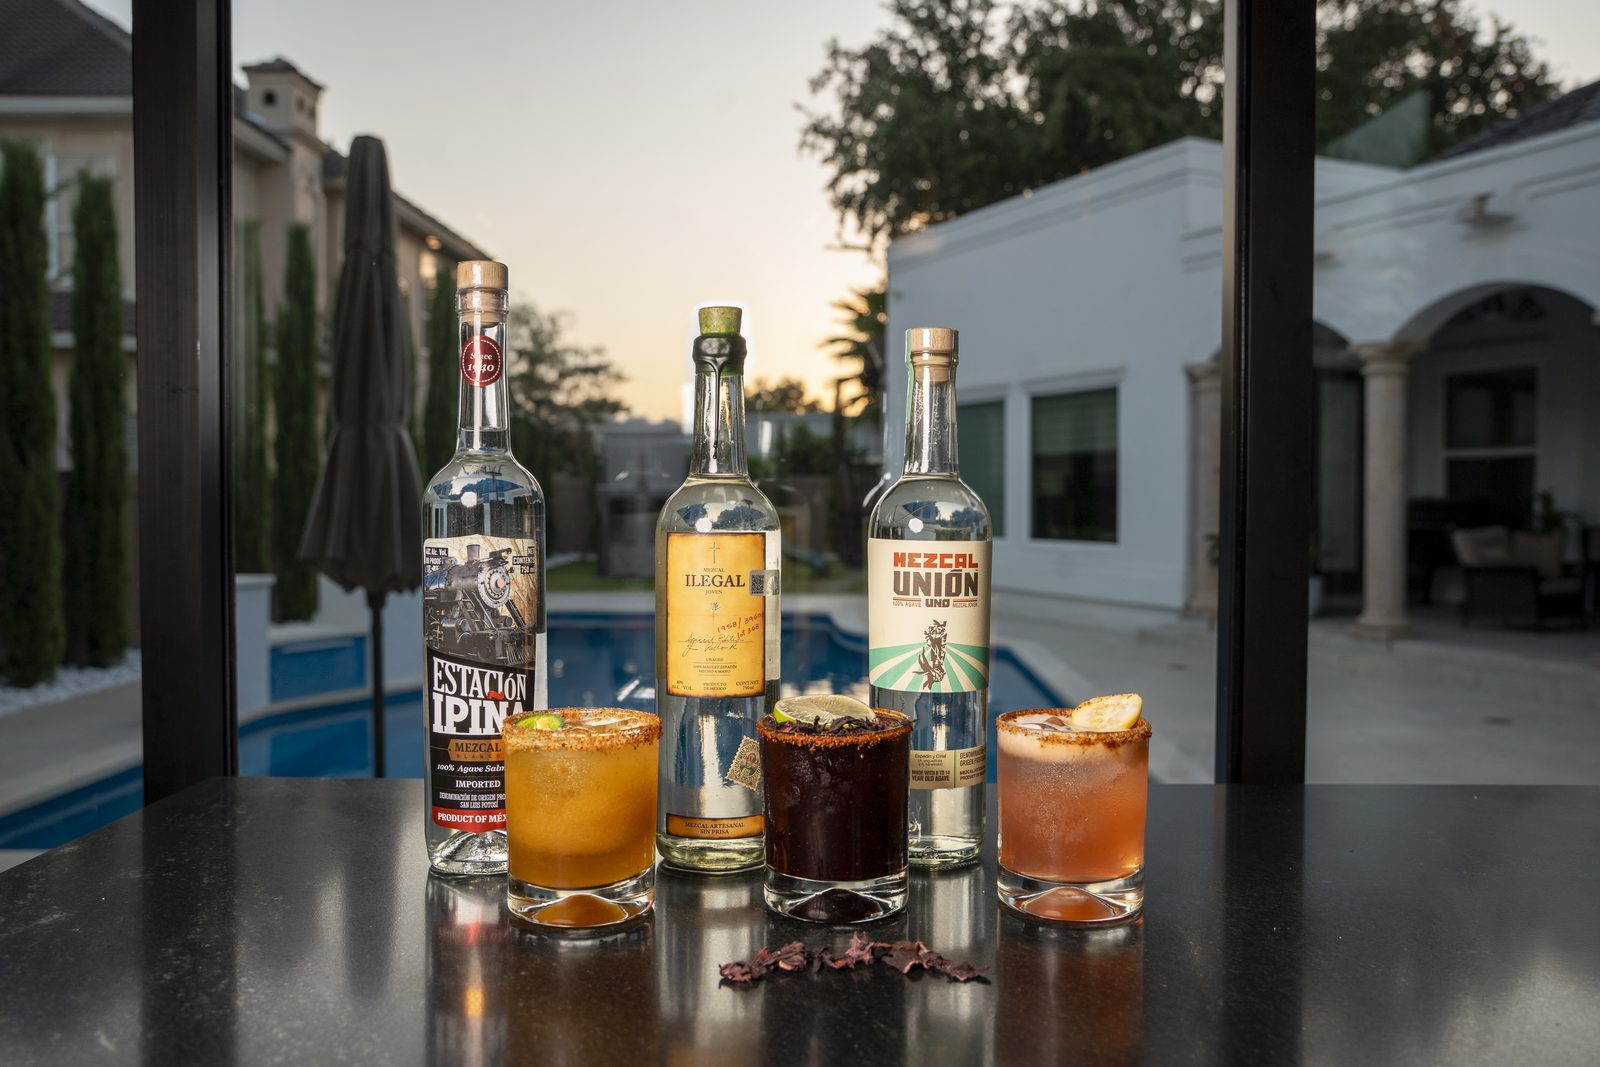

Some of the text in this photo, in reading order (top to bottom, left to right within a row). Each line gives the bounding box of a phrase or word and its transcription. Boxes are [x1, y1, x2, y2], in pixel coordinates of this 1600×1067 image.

[470, 352, 493, 360] Snce
[893, 552, 978, 568] MEZCAL
[685, 574, 746, 588] ILEGAL
[893, 569, 978, 597] UNIÓN
[925, 599, 950, 608] UNO
[432, 656, 527, 701] ESTACIÓN
[455, 742, 502, 752] MEZCAL
[437, 764, 455, 772] 100%
[457, 764, 484, 773] Agave
[455, 780, 501, 788] IMPORTED
[437, 812, 474, 823] PRODUCT
[475, 815, 487, 823] OF
[684, 821, 709, 829] MEZCAL
